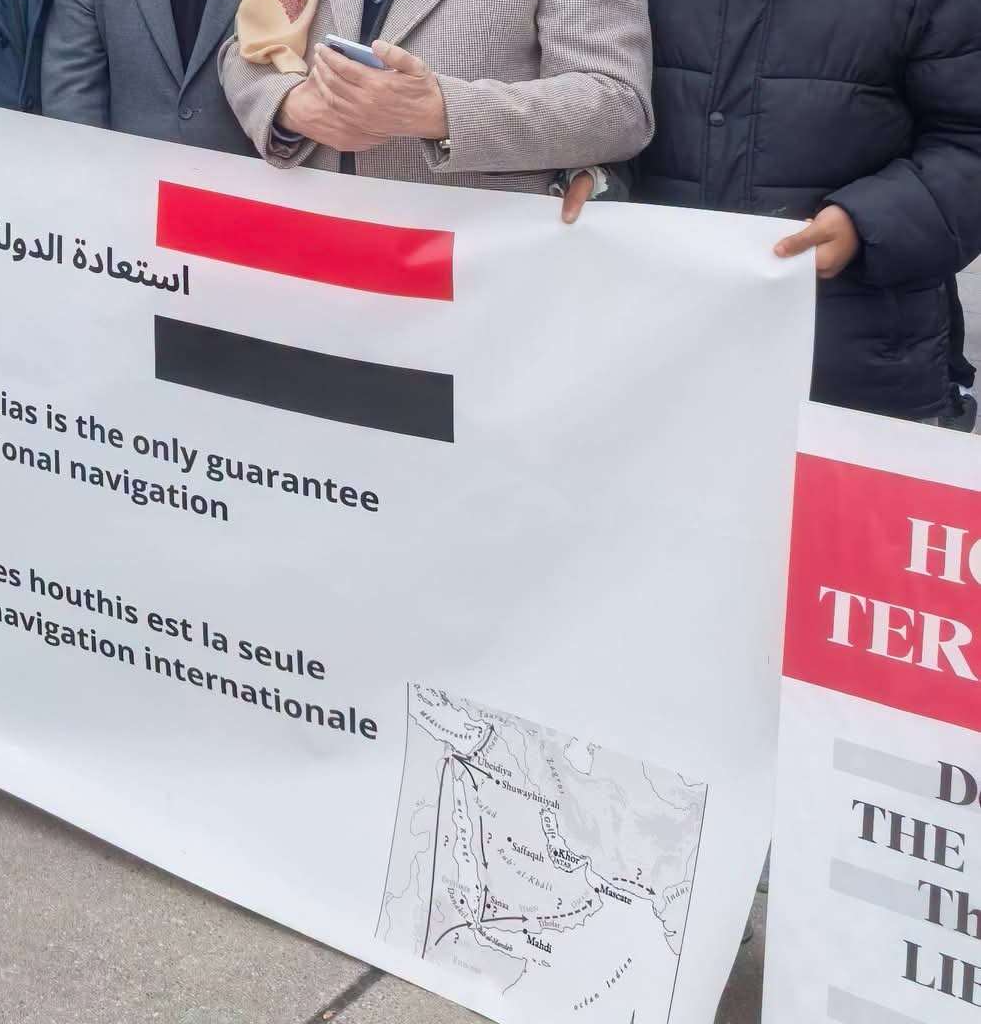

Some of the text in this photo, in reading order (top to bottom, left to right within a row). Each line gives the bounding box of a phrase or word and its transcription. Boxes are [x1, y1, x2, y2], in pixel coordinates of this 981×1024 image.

[73, 238, 190, 296] استعادة
[46, 404, 67, 433] is
[76, 415, 124, 448] the
[133, 435, 198, 473] only
[207, 453, 379, 512] guarantee
[71, 459, 229, 521] navigation
[904, 516, 981, 586] H
[30, 568, 138, 625] houthis
[148, 612, 192, 642] est
[202, 622, 228, 653] la
[239, 640, 325, 680] seule
[818, 586, 981, 681] TER
[145, 646, 378, 740] internationale
[935, 760, 981, 808] D
[559, 848, 580, 865] Khor
[852, 799, 965, 873] THE
[918, 879, 981, 940] Th
[527, 934, 553, 954] Mahdi
